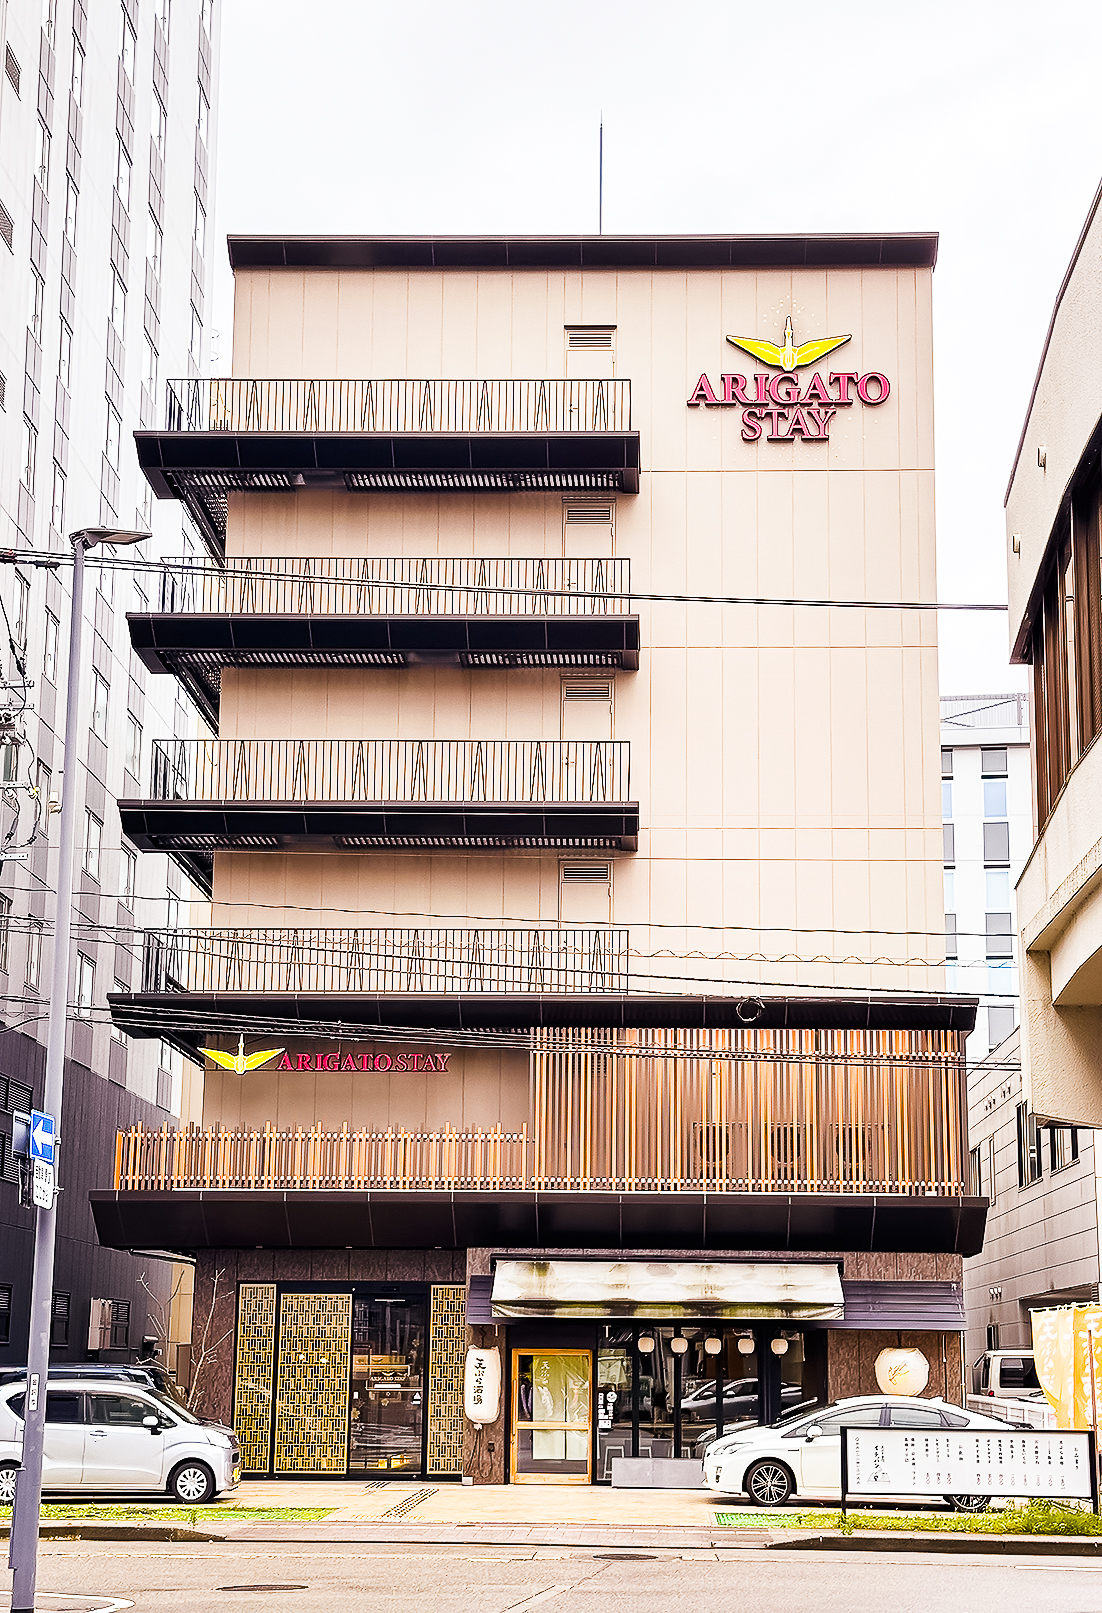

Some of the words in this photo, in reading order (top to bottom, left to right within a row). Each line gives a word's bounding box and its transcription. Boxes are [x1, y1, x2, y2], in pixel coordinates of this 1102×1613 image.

[687, 372, 890, 407] ARIGATO
[741, 408, 836, 441] STAY
[277, 1052, 392, 1072] ARIGATO
[395, 1052, 451, 1072] STAY
[473, 1357, 486, 1405] 天ぷら酒場
